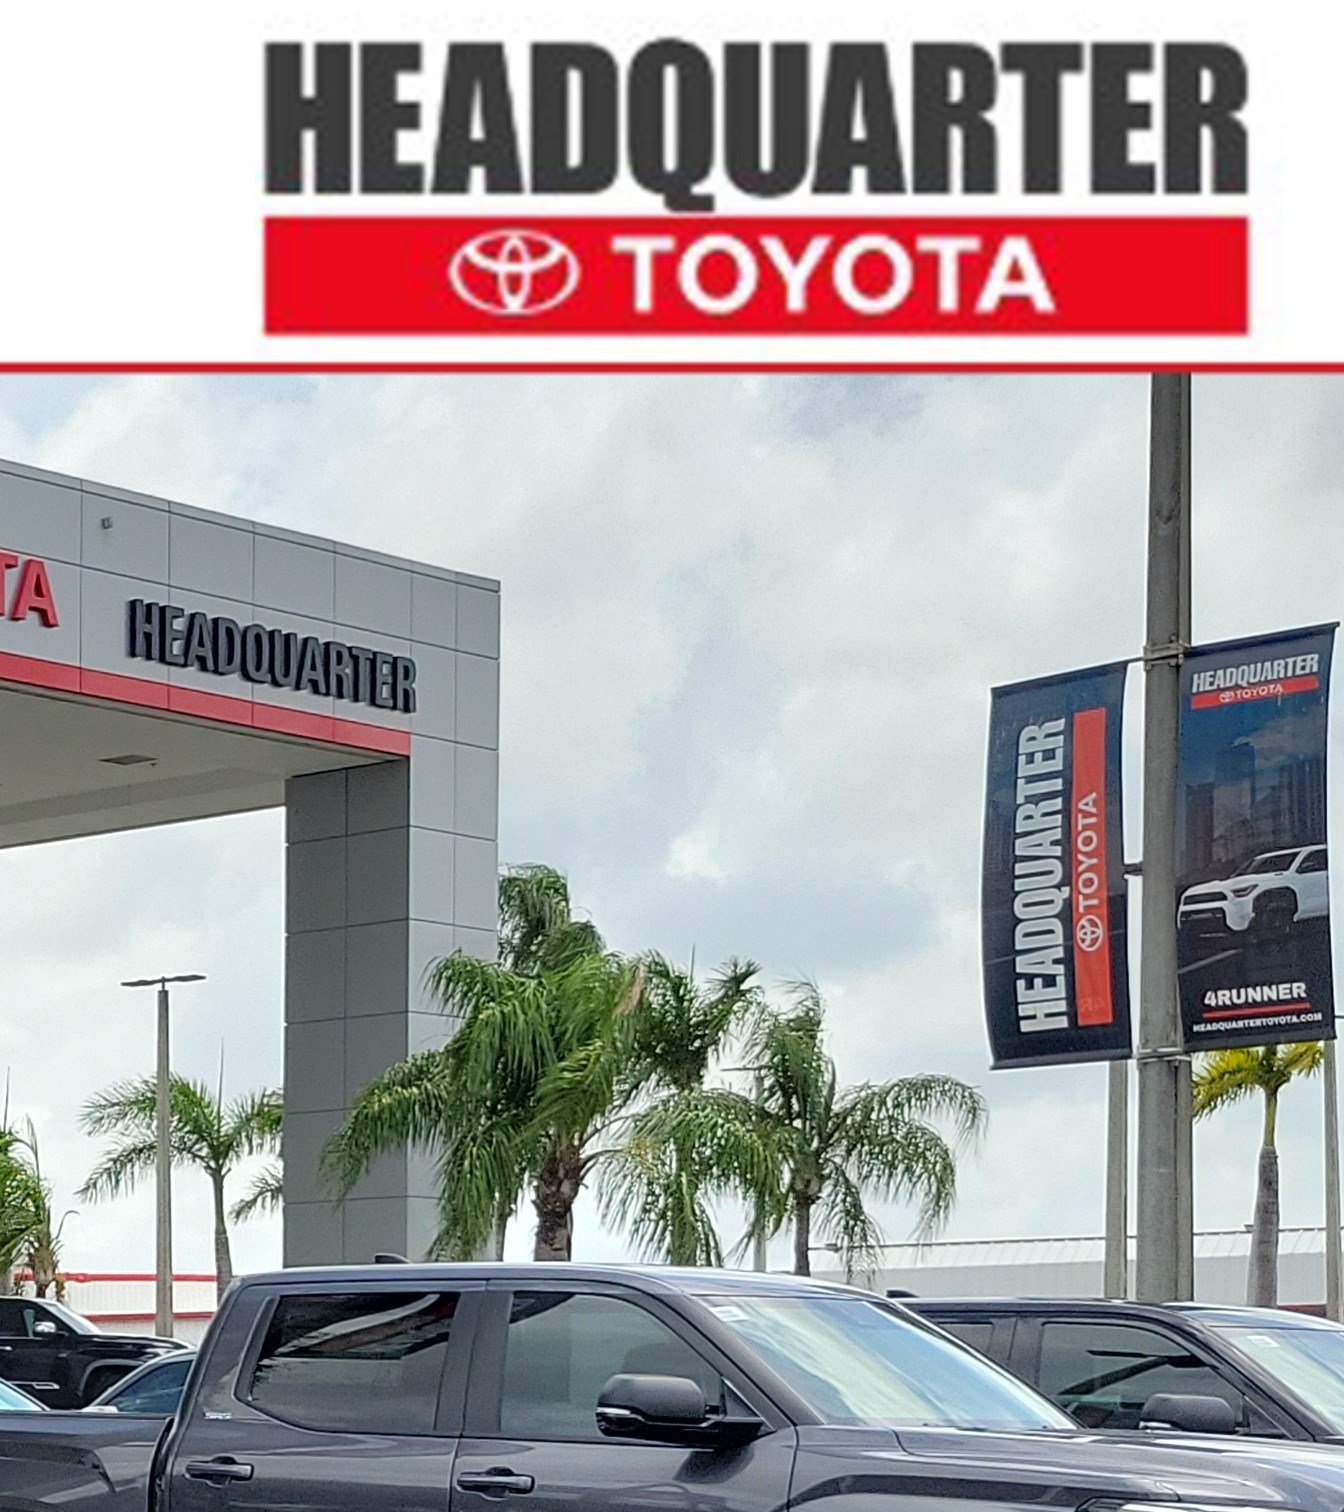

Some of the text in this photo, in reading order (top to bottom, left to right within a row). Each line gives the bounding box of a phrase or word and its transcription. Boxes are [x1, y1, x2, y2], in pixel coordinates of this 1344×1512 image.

[127, 599, 417, 713] HEADQUARTER
[1192, 653, 1320, 694] HEADQUARTER
[1235, 683, 1284, 699] TOYOTA
[1077, 791, 1100, 913] TOYOTA
[1013, 717, 1070, 1033] HEADQUARTER
[1204, 982, 1308, 1007] 4RUNNER
[1192, 1012, 1323, 1033] HEADQUARTERTOYOTA.COM
